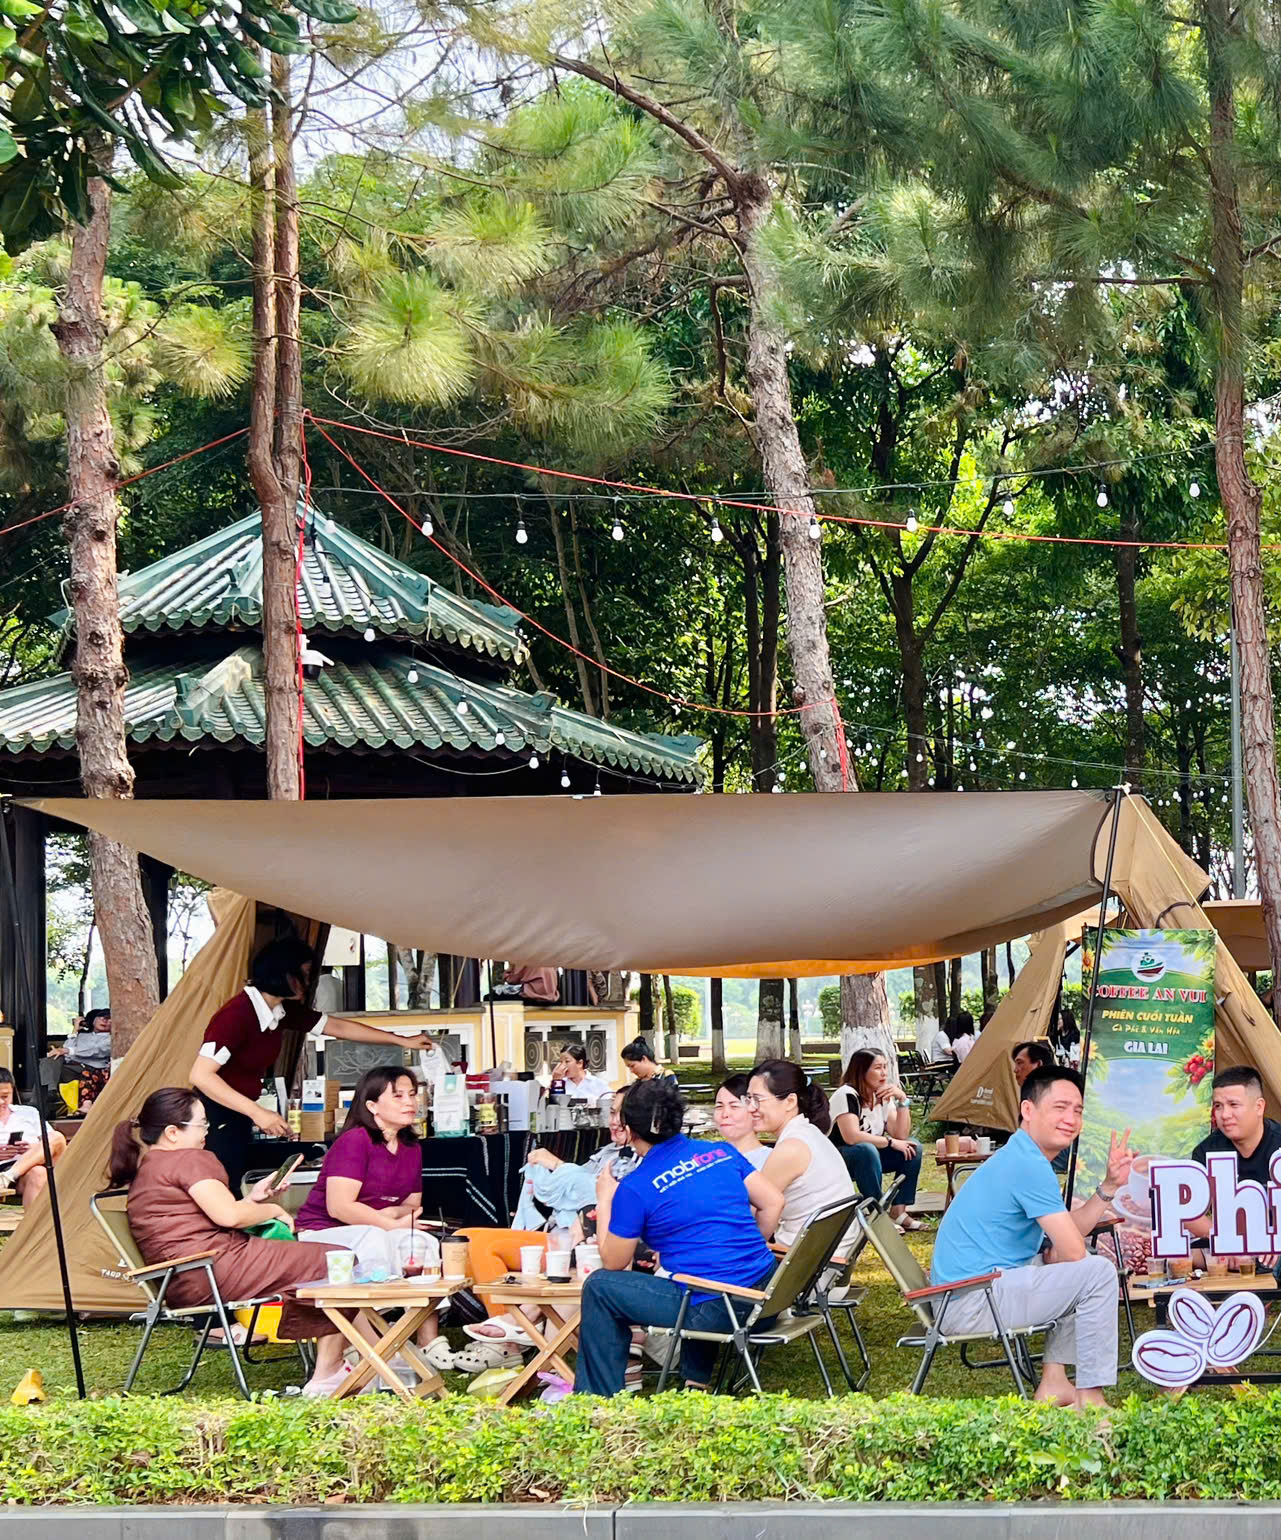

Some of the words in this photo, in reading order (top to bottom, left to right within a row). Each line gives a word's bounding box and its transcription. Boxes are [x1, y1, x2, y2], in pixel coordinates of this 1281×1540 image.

[1151, 987, 1176, 1002] AN
[1178, 989, 1207, 1003] VUI
[1123, 1041, 1146, 1054] GIA
[1147, 1042, 1169, 1055] LAI
